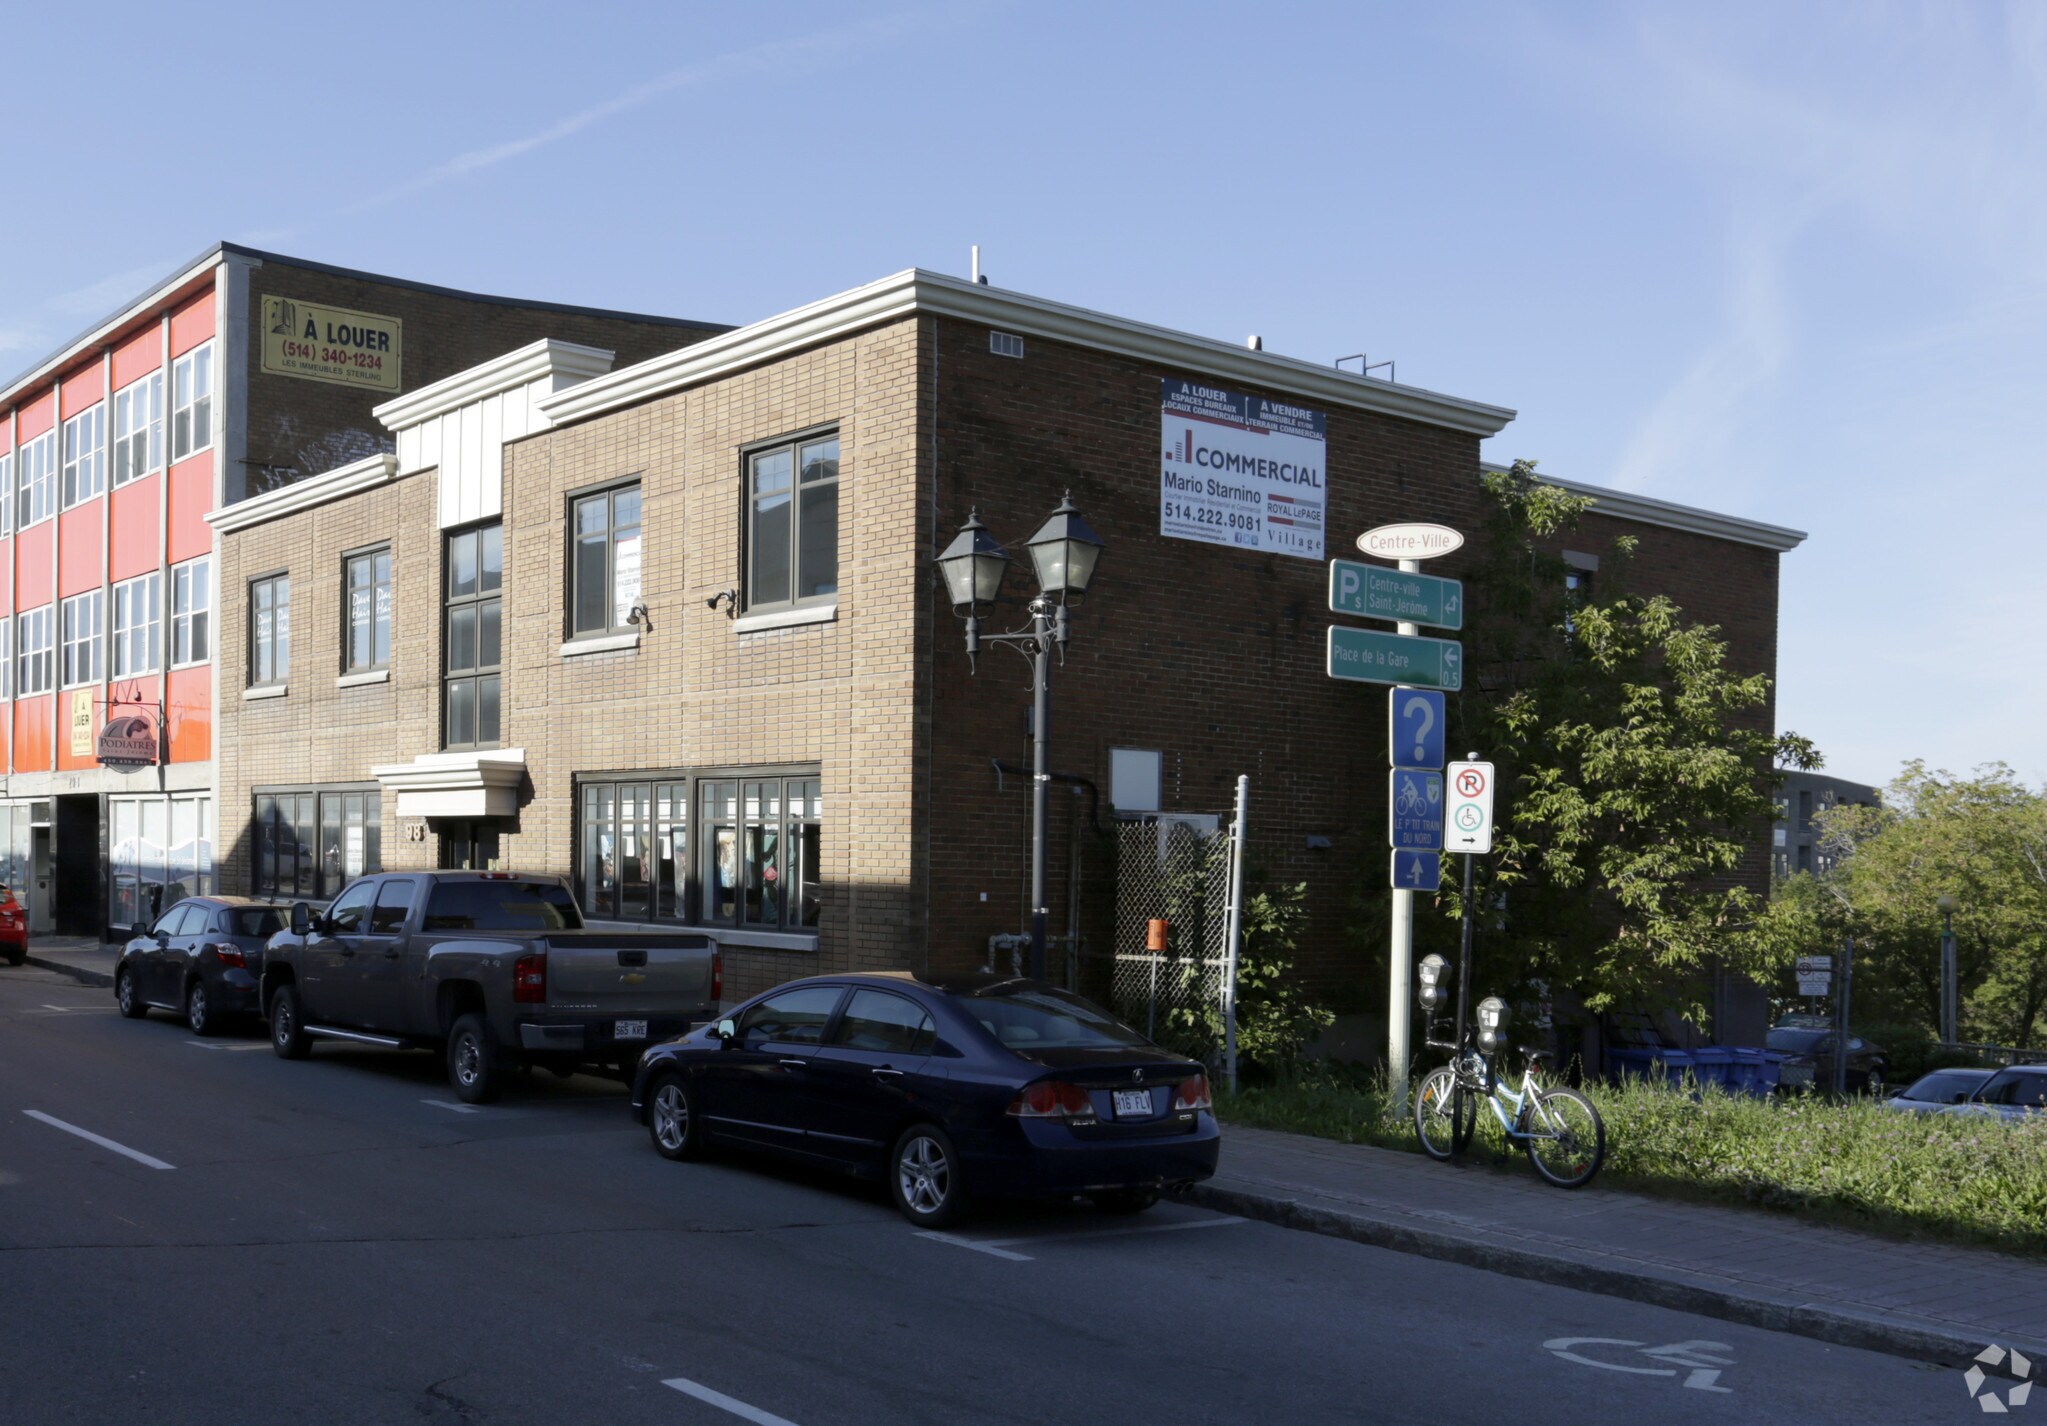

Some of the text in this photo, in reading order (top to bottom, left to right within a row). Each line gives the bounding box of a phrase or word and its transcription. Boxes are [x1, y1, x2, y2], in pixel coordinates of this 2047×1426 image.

[304, 312, 389, 352] À LOUER
[282, 339, 382, 370] (514) 340-1234
[282, 359, 381, 381] LES IMMEUBLES STERLING
[1171, 392, 1237, 413] ESPACES BUREAUX
[1192, 385, 1227, 402] LOUER
[1163, 400, 1244, 424] LOCAUX COMMERCIAUX
[1259, 412, 1296, 426] IMMEUBLE
[1271, 403, 1313, 421] VENDRE
[1249, 418, 1324, 440] TERRAIN COMMERCIAL
[1195, 447, 1322, 488] COMMERCIAL
[1164, 471, 1261, 503] Mario Starnino
[1164, 502, 1261, 532] 514.222.9081
[1267, 502, 1292, 516] ROYAL
[1267, 530, 1321, 551] Village
[1370, 533, 1450, 549] Centre-Ville
[1339, 569, 1360, 604] P
[1369, 575, 1421, 597] Centre-ville
[1334, 644, 1409, 668] Place de la Gare
[100, 738, 156, 750] PODIATRES
[1395, 818, 1402, 830] LE
[1423, 819, 1440, 832] TRAIN
[1403, 832, 1432, 844] DU NORD
